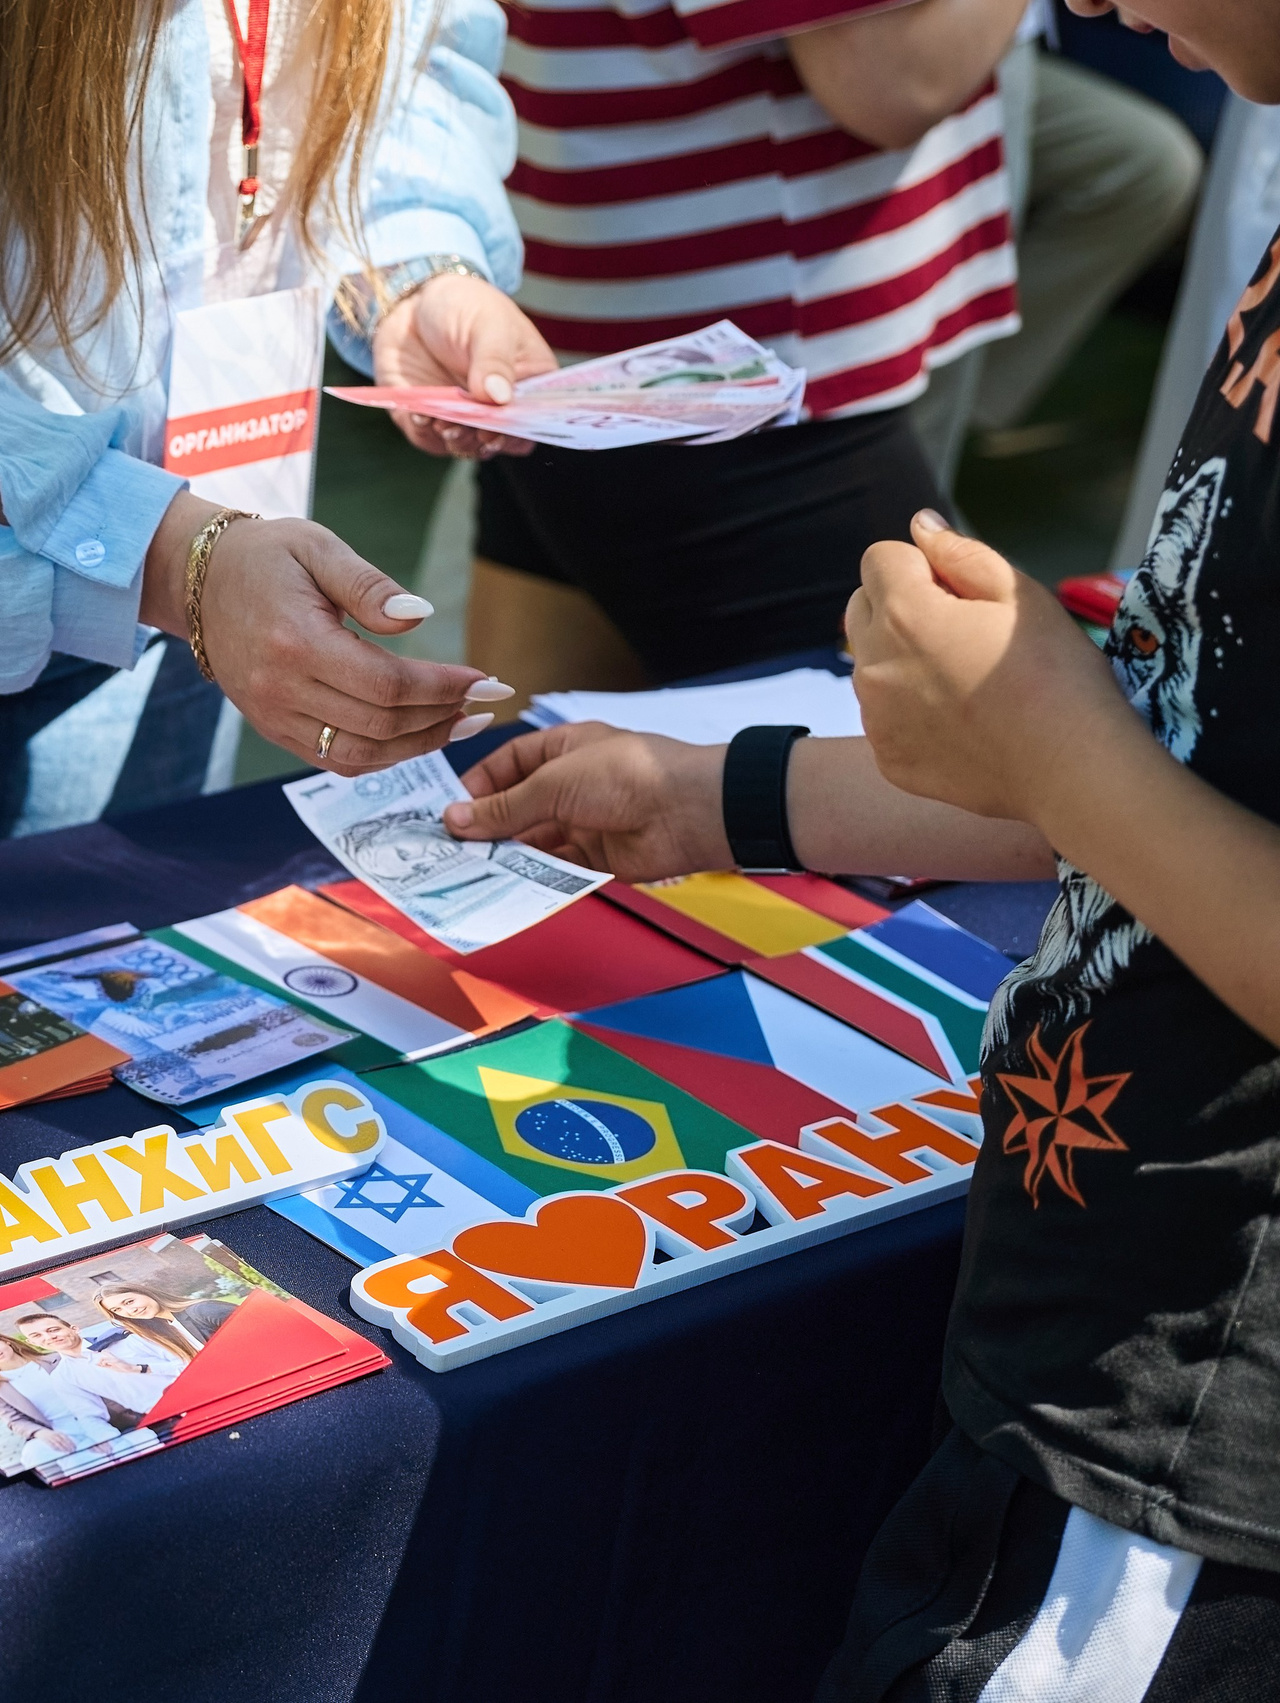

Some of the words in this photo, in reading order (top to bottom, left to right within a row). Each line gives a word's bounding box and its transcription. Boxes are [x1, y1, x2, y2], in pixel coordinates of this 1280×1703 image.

[170, 408, 307, 458] ОРГАНИЗАТОР
[598, 1125, 624, 1163] PROGRESSO
[363, 1249, 535, 1343] Я
